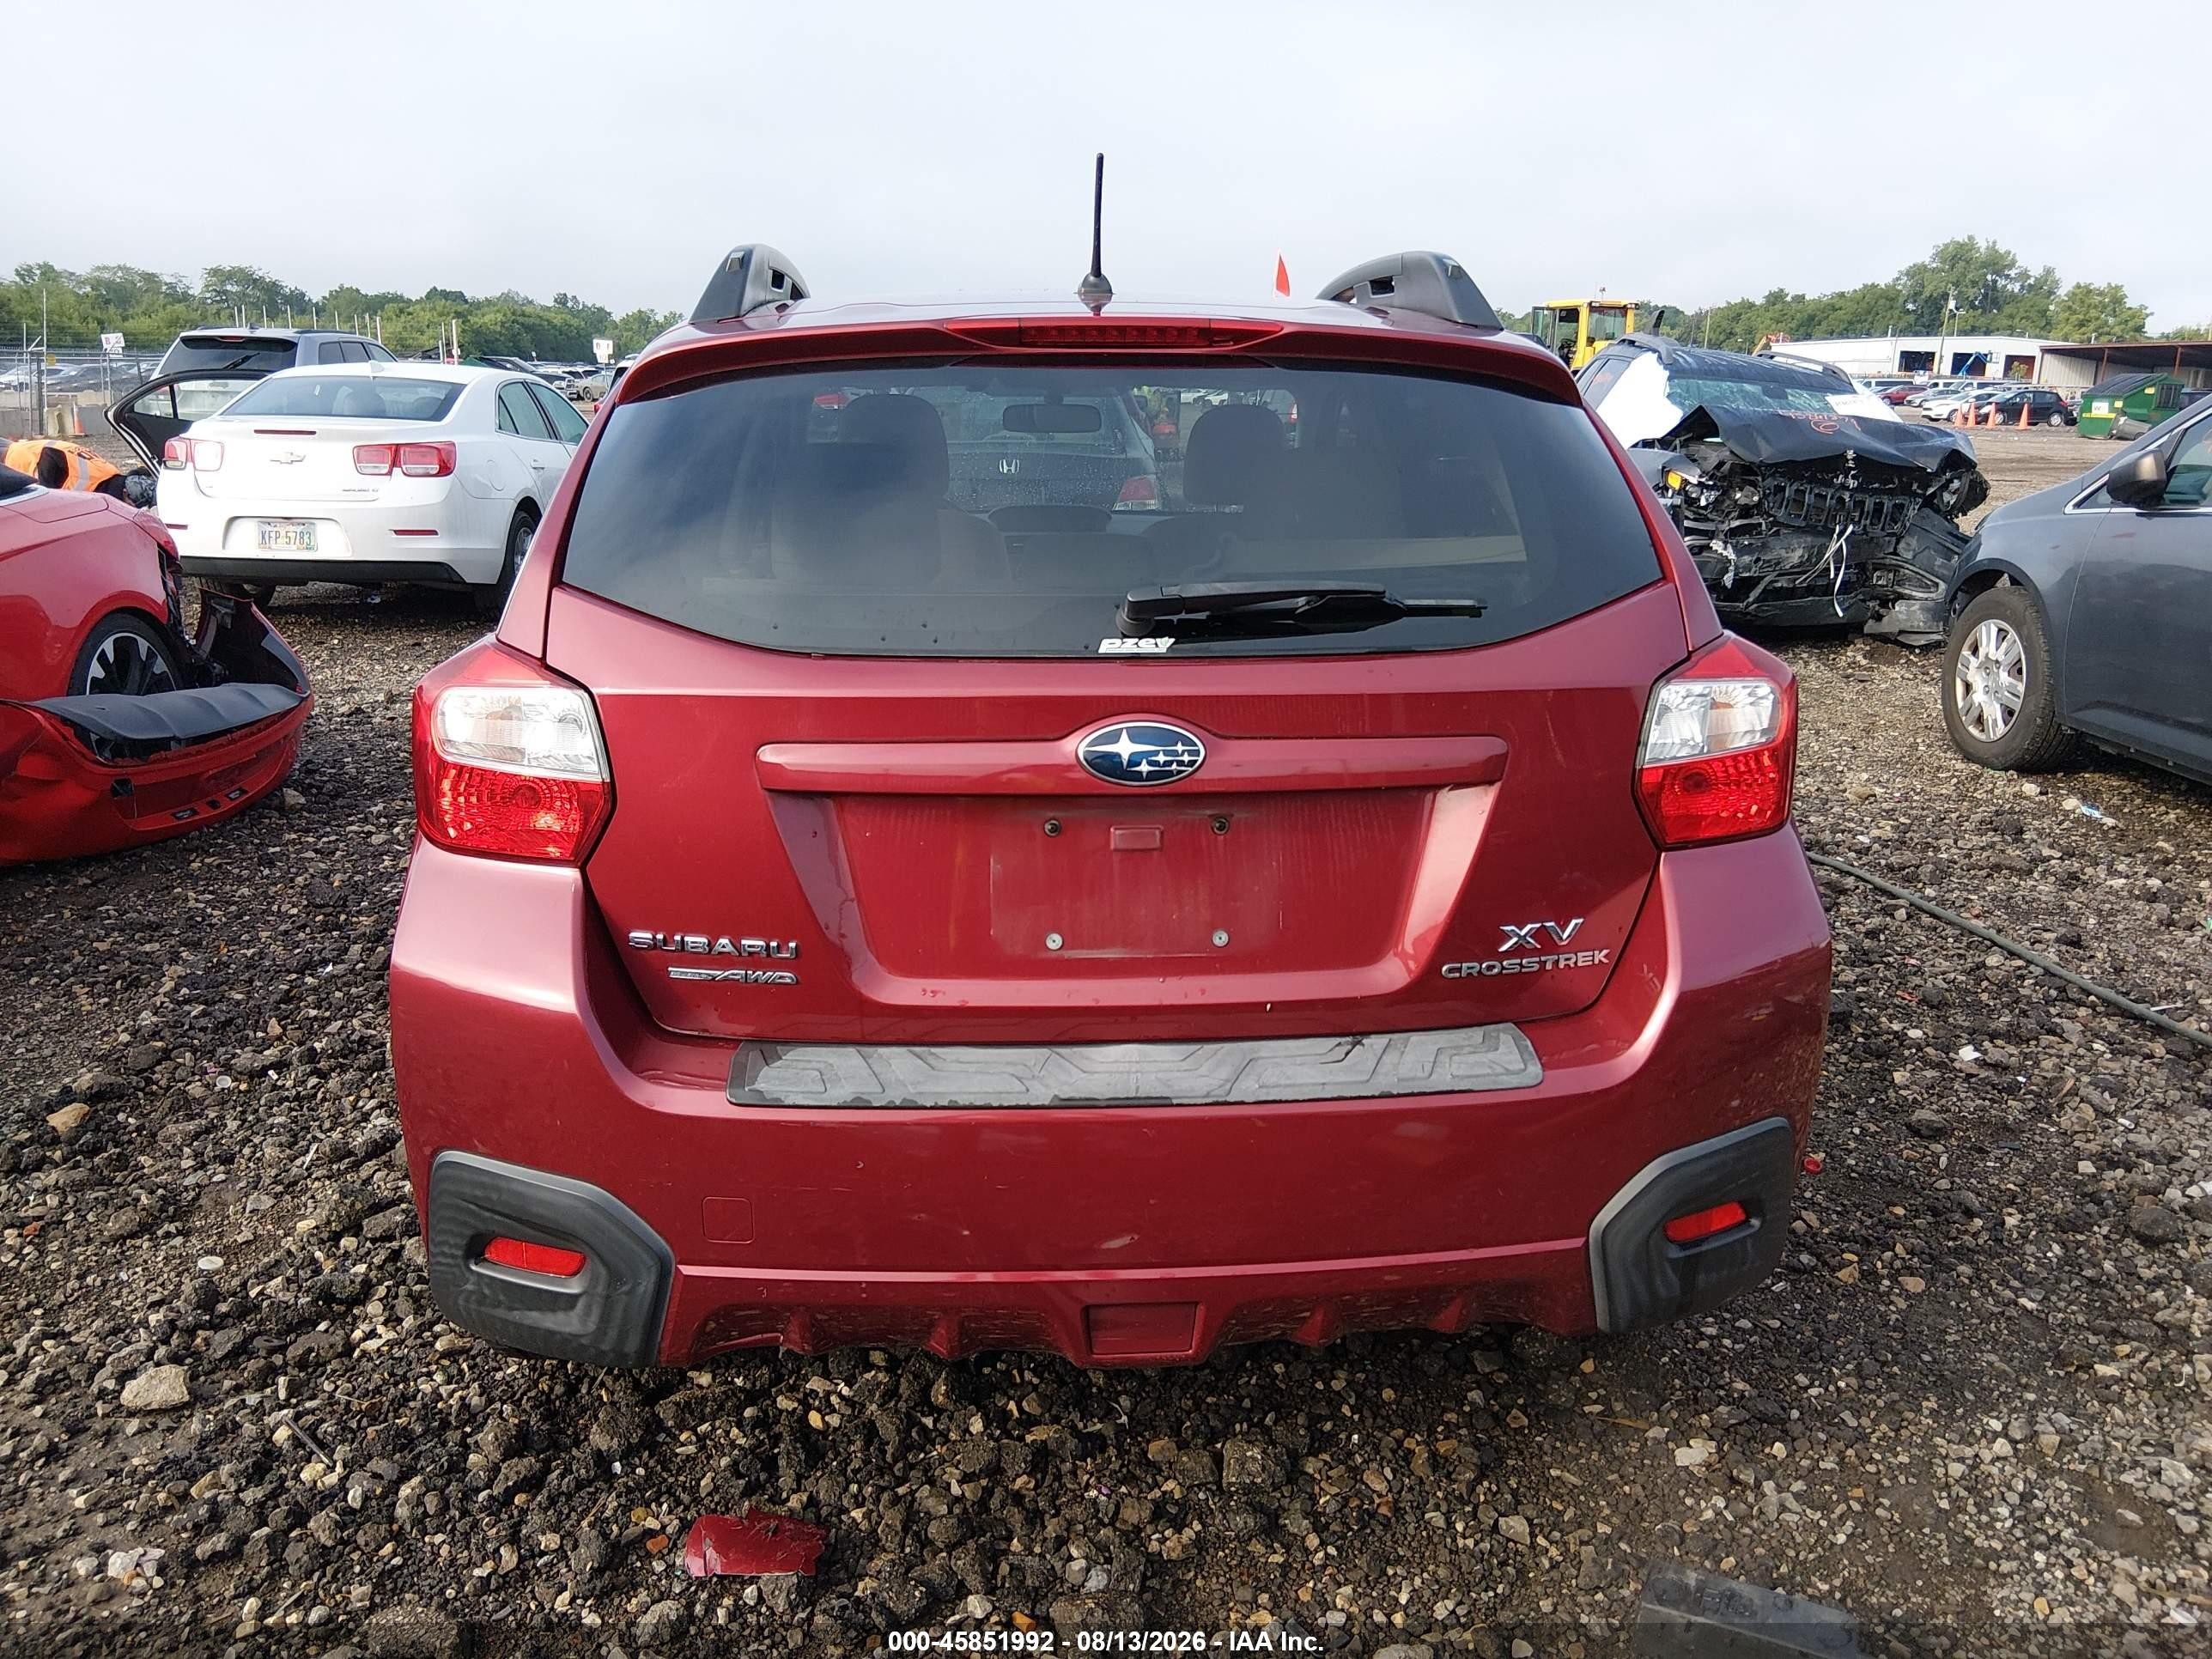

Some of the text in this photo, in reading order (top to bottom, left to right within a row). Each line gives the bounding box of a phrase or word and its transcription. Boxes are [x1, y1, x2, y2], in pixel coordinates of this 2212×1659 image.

[285, 530, 312, 546] 5783
[628, 931, 798, 959] SUBARU
[1498, 918, 1584, 952] XV
[715, 969, 798, 986] AWD
[1441, 949, 1611, 980] CROSSTREK
